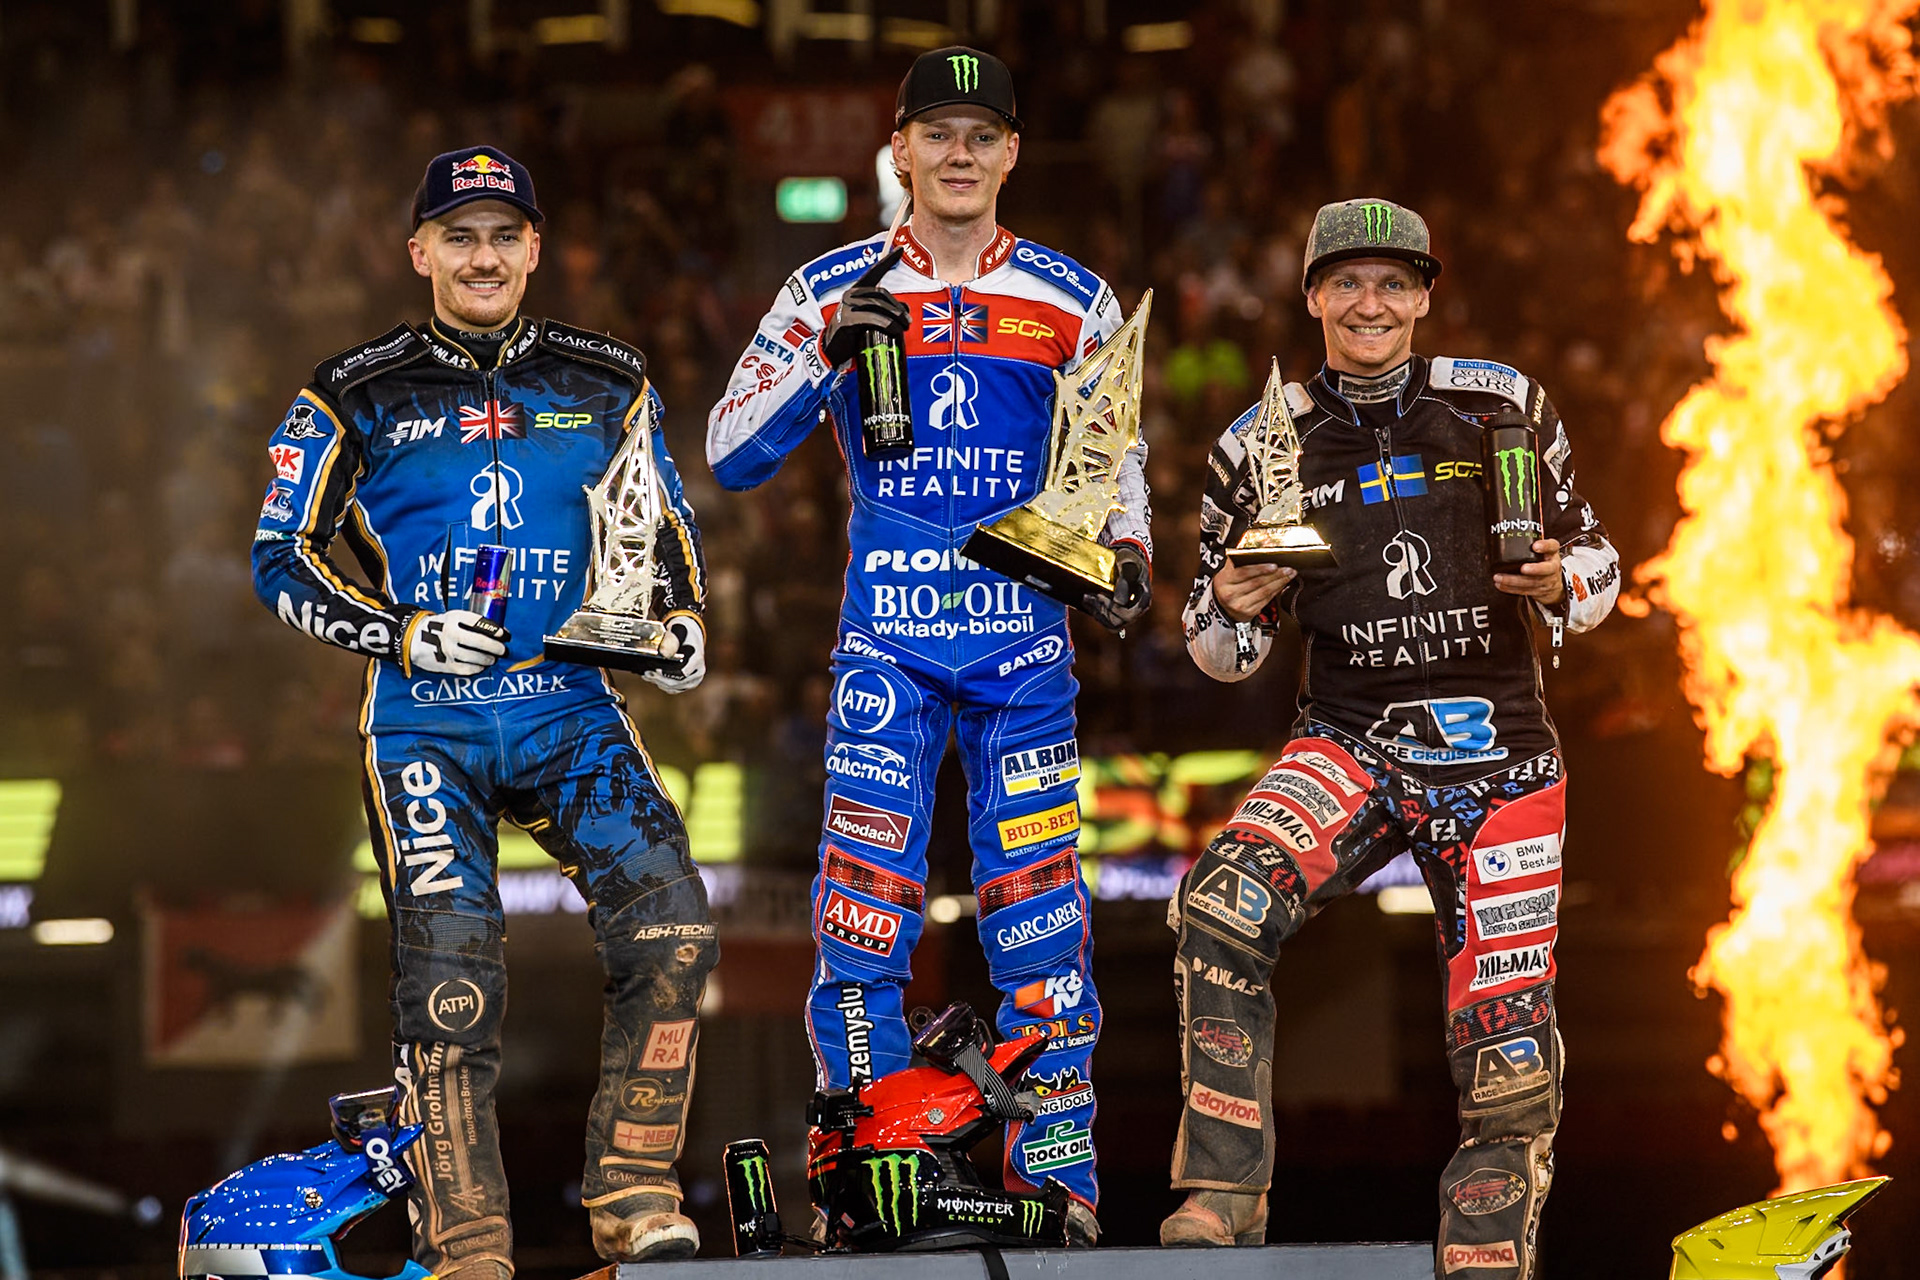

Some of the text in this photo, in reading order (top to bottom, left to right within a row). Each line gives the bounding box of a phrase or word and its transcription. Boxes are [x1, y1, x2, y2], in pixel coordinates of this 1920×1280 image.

[453, 174, 515, 193] Red Bull
[809, 250, 883, 290] PŁOMY
[997, 317, 1055, 340] SGP
[343, 346, 364, 367] Jörg
[363, 332, 411, 355] Grohmann
[548, 331, 643, 372] GARCAREK
[754, 333, 795, 365] BETA
[1450, 375, 1515, 396] CARS
[1451, 369, 1516, 385] EXCLUSIVE
[387, 417, 446, 445] FIM
[534, 412, 592, 429] SGP
[878, 476, 1022, 499] REALITY
[419, 547, 571, 578] INFITE
[864, 548, 991, 573] PŁOM
[872, 582, 1033, 619] BIO OIL
[276, 590, 390, 655] Nice
[872, 616, 1035, 640] wkłady-biooil
[1342, 604, 1490, 647] INFINITE
[999, 638, 1058, 677] BATEX
[1349, 632, 1492, 669] REALITY
[411, 673, 567, 704] GARCAREK
[841, 688, 886, 717] ATPI
[1005, 740, 1077, 776] ALBON
[1377, 741, 1409, 759] ACE
[826, 753, 911, 790] automax
[1039, 772, 1060, 788] plc
[400, 760, 464, 898] Nice
[832, 812, 897, 844] Alpodach
[1005, 809, 1075, 842] BUD-BET
[1516, 843, 1544, 858] BMW
[1520, 855, 1560, 871] Best Auto
[1199, 866, 1271, 923] AB
[1477, 888, 1556, 927] NICKSON
[826, 898, 898, 940] AMD
[997, 899, 1082, 948] GARCAREK
[1190, 894, 1258, 936] RACE CRUISERS
[1483, 922, 1506, 937] LAST
[633, 924, 708, 941] ASH-TECH
[826, 922, 888, 951] GROUP
[1472, 975, 1506, 987] SWEDEN
[438, 994, 474, 1015] ATPI
[657, 1027, 686, 1046] MU
[651, 1048, 680, 1063] RA
[1476, 1040, 1543, 1089] AB
[459, 1065, 471, 1098] Broke
[1475, 1087, 1499, 1101] RACE
[424, 1041, 454, 1182] Jörg Grohmann
[643, 1129, 676, 1143] NEB
[1027, 1138, 1090, 1165] ROCK OIL
[937, 1197, 1015, 1218] MONSTER
[948, 1213, 1003, 1225] ENERGY
[1446, 1247, 1514, 1265] daytona
